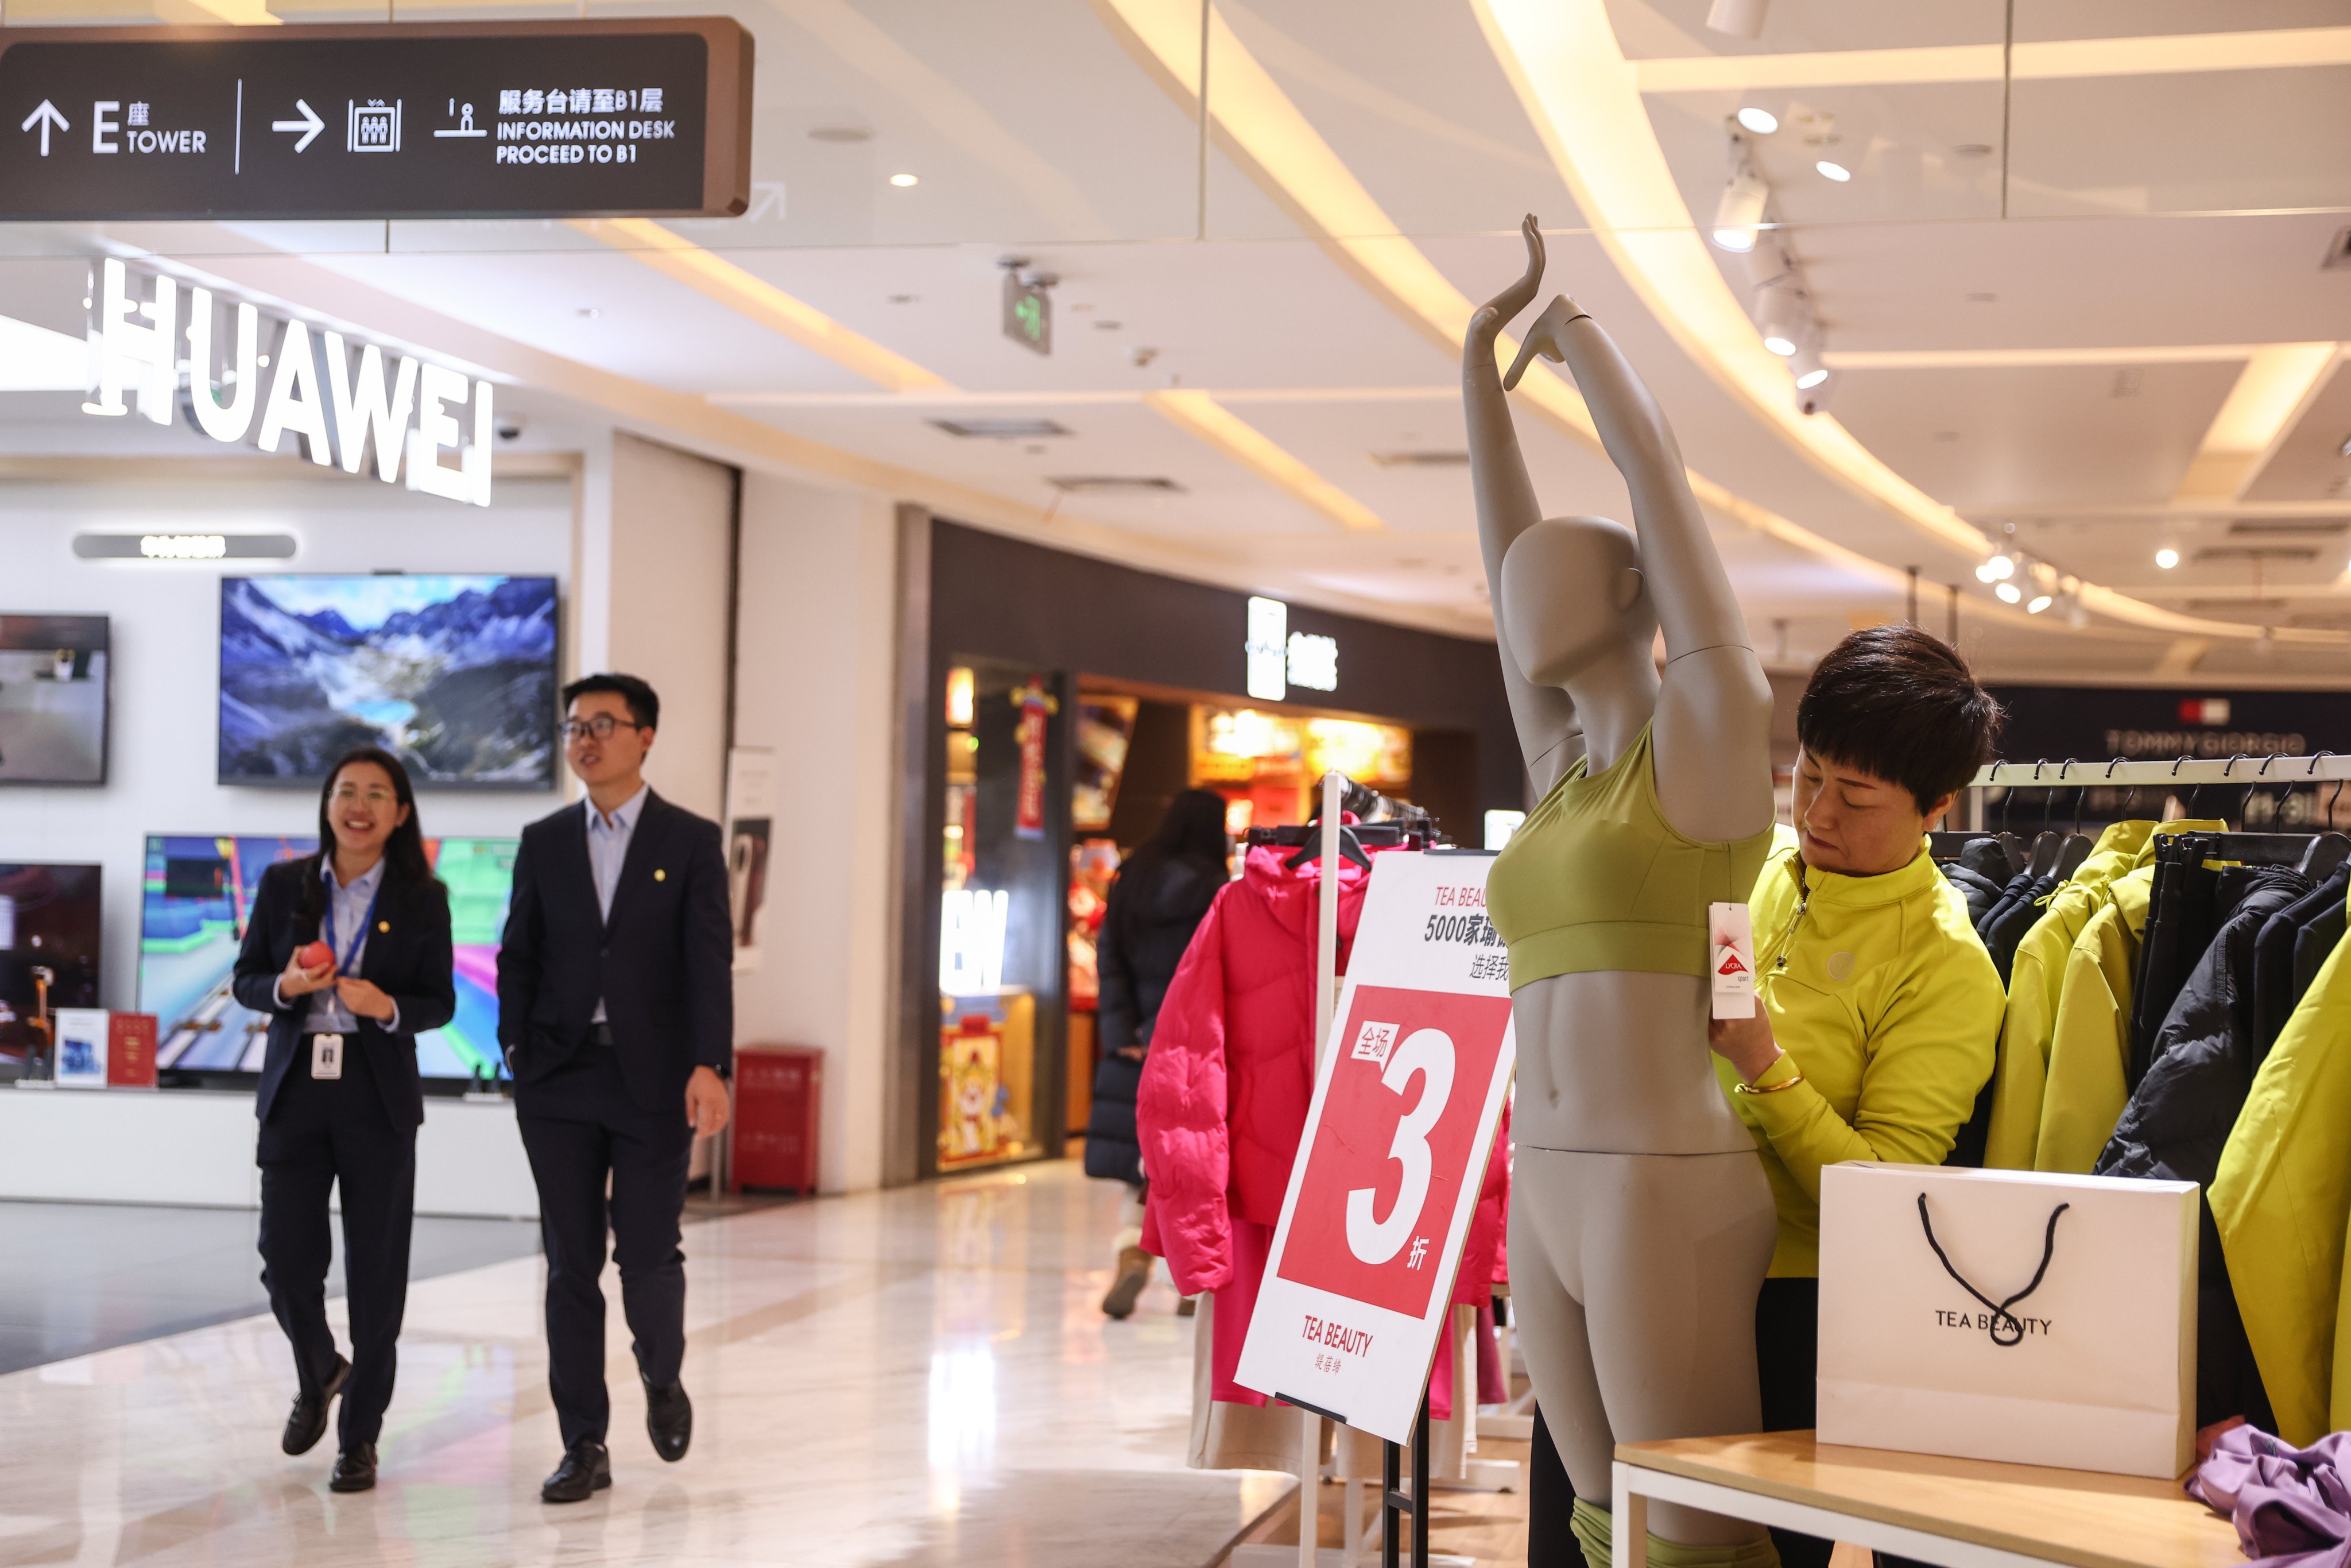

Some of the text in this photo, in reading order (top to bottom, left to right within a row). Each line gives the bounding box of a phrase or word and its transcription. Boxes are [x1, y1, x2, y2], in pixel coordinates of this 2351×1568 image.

[498, 88, 664, 115] 服务台请至B1层
[92, 100, 150, 153] E 座
[497, 119, 676, 141] INFORMATION DESK
[126, 130, 207, 153] TOWER
[496, 144, 637, 165] PROCEED TO B1
[102, 257, 493, 508] HUAWEI
[1435, 886, 1486, 907] TEA BEAU
[1424, 913, 1509, 948] 5000家瑜
[1469, 953, 1509, 981] 选择我
[1358, 1026, 1389, 1058] 全场
[1346, 1027, 1457, 1271] 3 折
[1935, 1310, 1972, 1329] TEA
[1303, 1315, 1373, 1358] TEA BEAUTY
